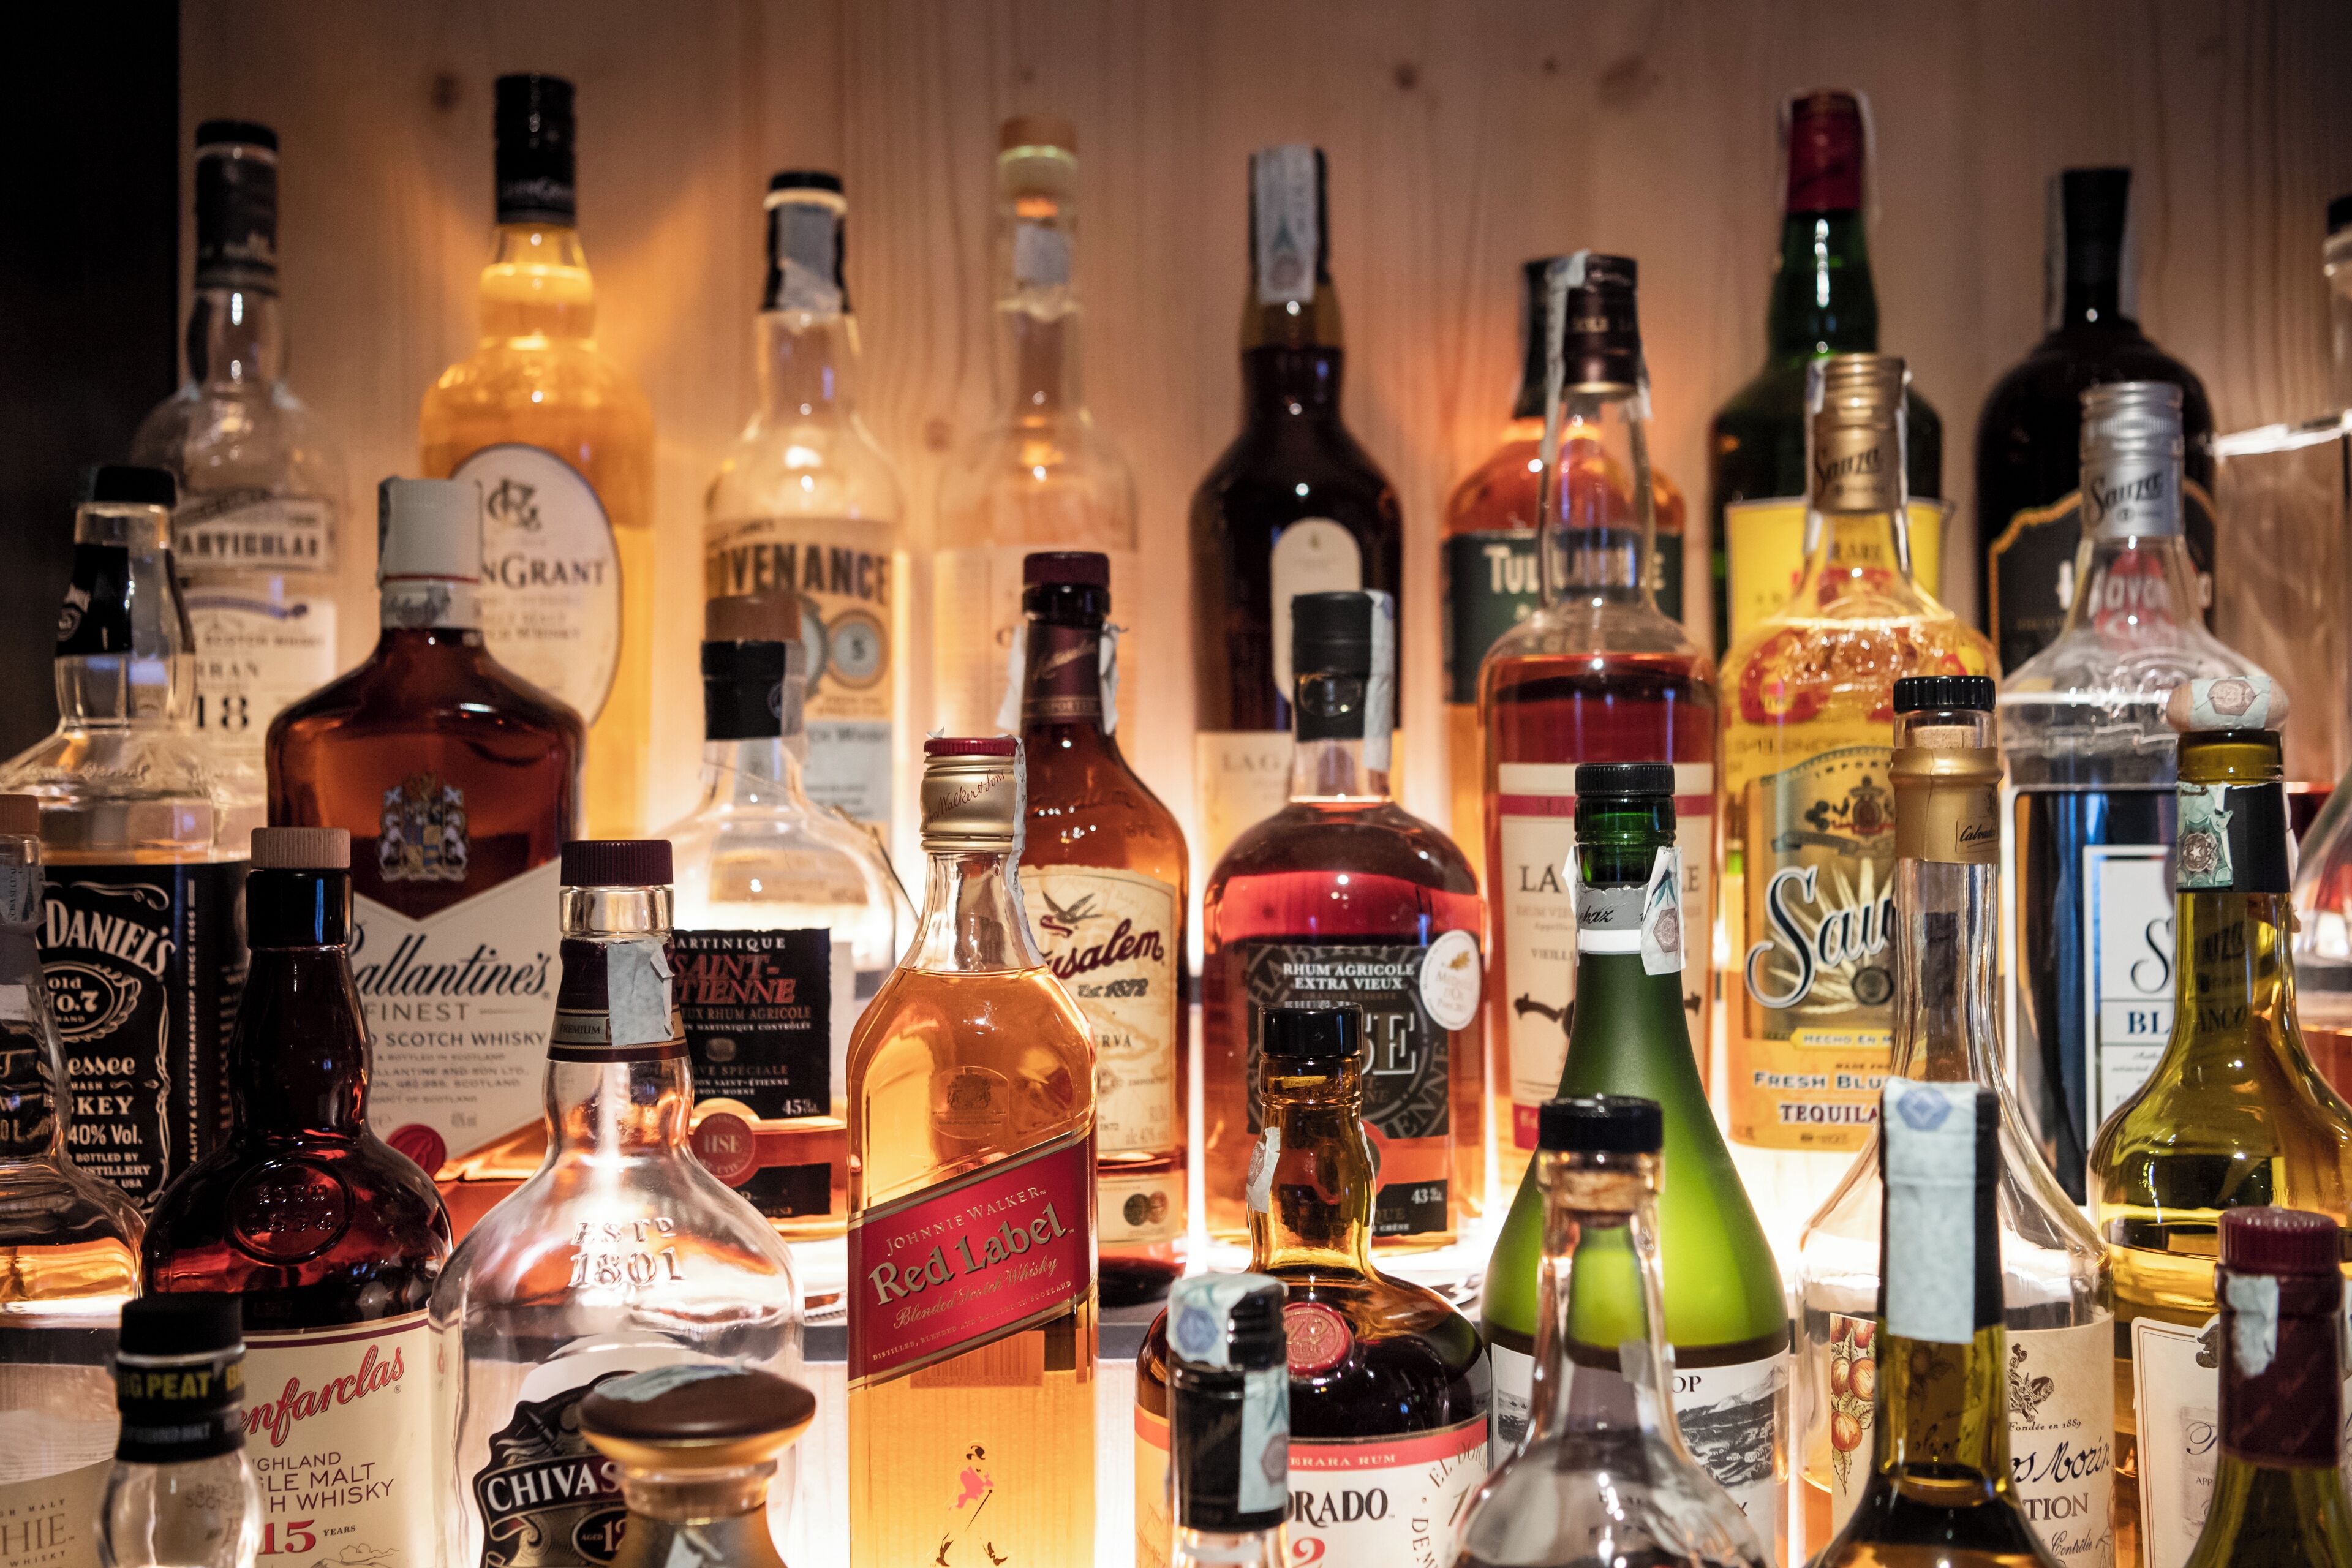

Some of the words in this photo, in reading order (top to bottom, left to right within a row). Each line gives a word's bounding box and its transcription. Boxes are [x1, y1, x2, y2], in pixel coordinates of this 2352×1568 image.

[2090, 470, 2164, 522] Sauza
[180, 532, 318, 557] ARTICULAR
[481, 552, 606, 589] NGRANT
[719, 543, 887, 606] VENANCE
[198, 695, 249, 729] 18
[1221, 753, 1282, 772] LAG
[940, 786, 978, 815] Walker
[45, 899, 176, 976] DANIEL'S
[674, 937, 786, 952] ARTINIQUE
[1043, 918, 1164, 980] usalem
[1745, 864, 1894, 1008] Sau
[187, 944, 197, 987] SINCE
[2131, 916, 2174, 995] S
[1283, 962, 1330, 976] RHUM
[1334, 963, 1415, 977] AGRICOLE
[673, 978, 796, 1005] TIENNE
[1295, 978, 1348, 991] EXTRA
[1353, 977, 1404, 990] VIEUX
[559, 1023, 601, 1036] PREMIUM
[696, 1023, 754, 1033] MARTINIQUE
[2127, 1011, 2172, 1035] BL
[386, 1033, 464, 1047] SCOTCH
[471, 1031, 547, 1047] WHISKY
[1096, 1034, 1132, 1047] RVA
[68, 1056, 136, 1076] essee
[696, 1088, 756, 1096] ROS-MORNE
[1754, 1071, 1827, 1089] FRESH
[1836, 1074, 1886, 1090] BLU
[70, 1095, 135, 1115] KEY
[111, 1123, 143, 1145] Vol.
[75, 1152, 121, 1163] BOTTLED
[124, 1152, 138, 1162] BY
[81, 1165, 151, 1176] ISTILLERY
[121, 1178, 143, 1188] USA
[886, 1215, 965, 1257] JOHNNIE
[967, 1186, 1040, 1220] WALKER
[868, 1245, 956, 1306] Red
[955, 1201, 1067, 1275] Label
[568, 1246, 687, 1289] 1801
[892, 1292, 957, 1330] Blended
[958, 1276, 1005, 1306] Scotch
[1005, 1254, 1058, 1288] Whisky
[872, 1340, 919, 1362] DISTILLED,
[920, 1325, 957, 1344] BLENDED
[1029, 1280, 1072, 1304] SCOTLAND
[146, 1371, 212, 1400] PEAT
[2008, 1421, 2045, 1432] Fondée
[2062, 1418, 2082, 1430] 1889
[1289, 1456, 1352, 1468] ERARA
[1359, 1454, 1396, 1466] RUM
[2032, 1435, 2110, 1483] Morin
[310, 1462, 376, 1490] MALT
[2195, 1476, 2215, 1486] APP
[28, 1498, 65, 1513] MALT
[296, 1478, 394, 1512] WHISKY
[1287, 1488, 1389, 1528] RADO
[2022, 1492, 2089, 1521] TION
[258, 1519, 317, 1556] 15
[323, 1525, 356, 1537] YEARS
[9, 1550, 66, 1568] WHISKY
[1292, 1537, 1327, 1568] 2
